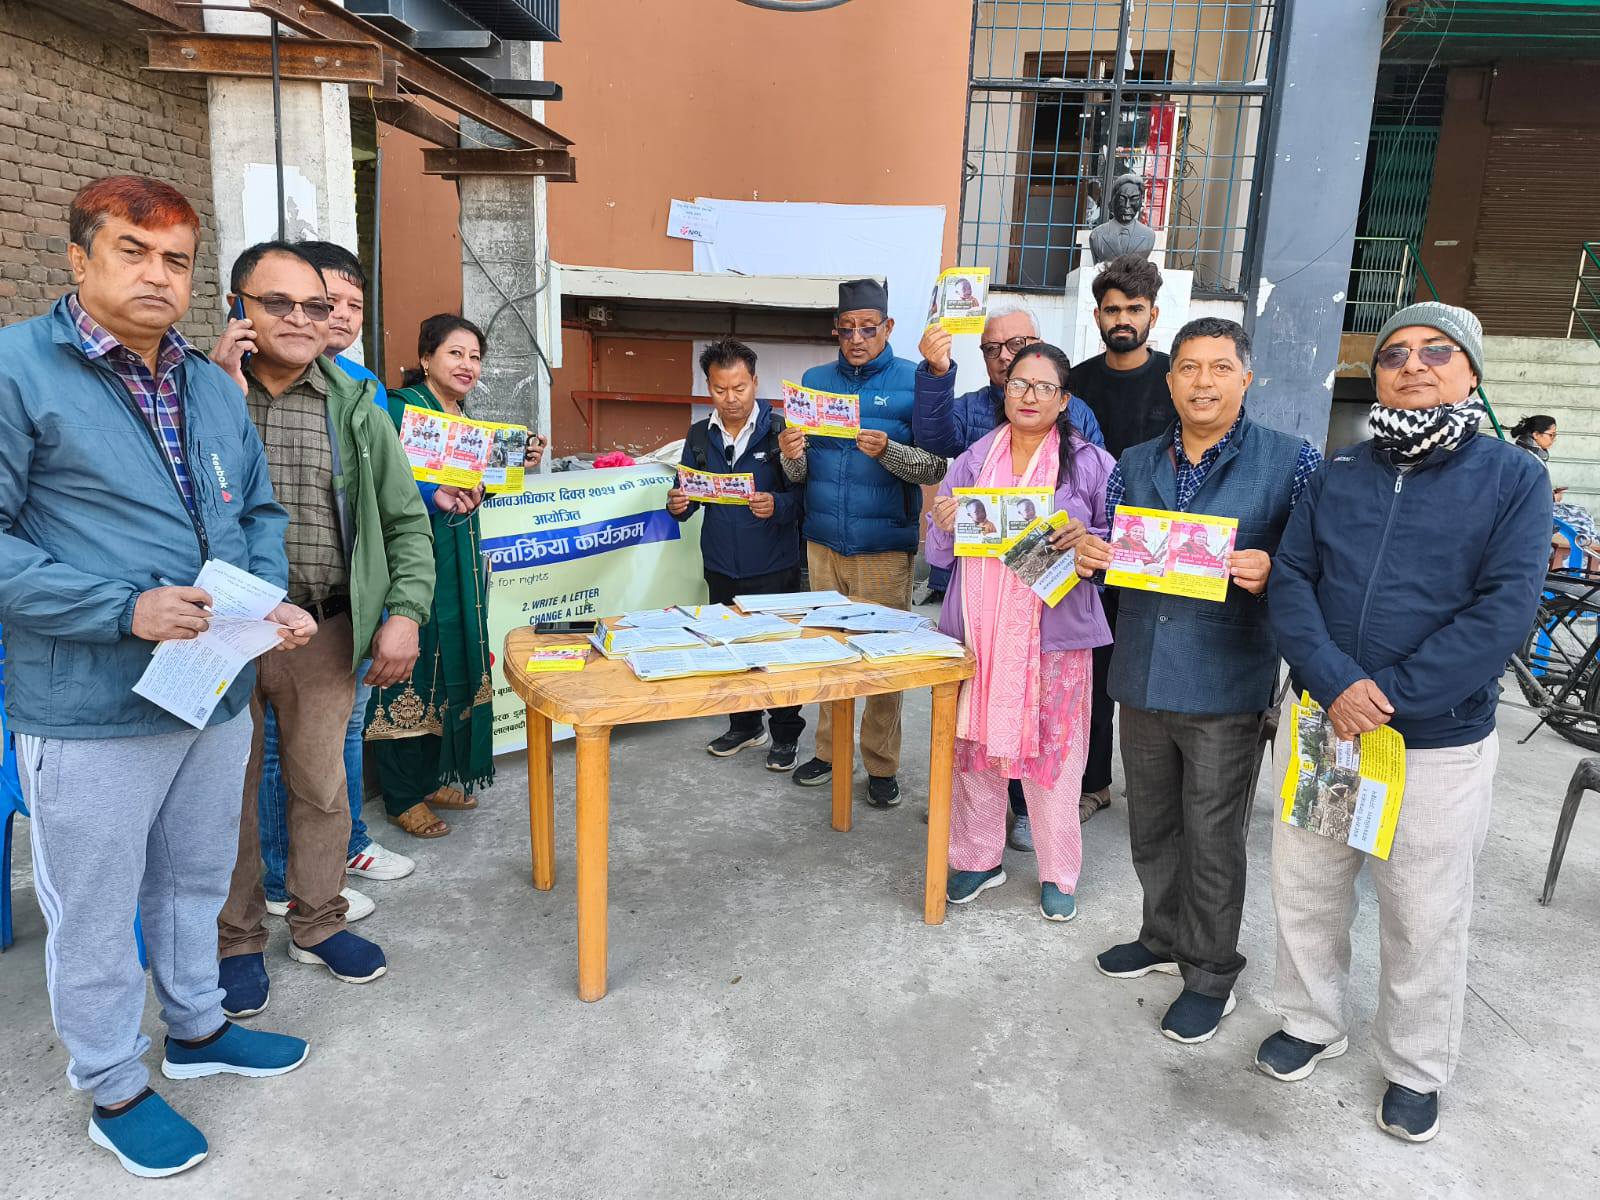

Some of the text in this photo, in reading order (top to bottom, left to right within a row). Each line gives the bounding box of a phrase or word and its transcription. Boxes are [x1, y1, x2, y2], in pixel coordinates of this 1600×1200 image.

[559, 488, 586, 500] दिवस
[588, 486, 616, 498] २०२५
[619, 480, 635, 491] को
[533, 509, 581, 525] आयोजित
[573, 522, 645, 551] कार्यक्रम
[498, 577, 515, 586] for
[519, 572, 550, 586] rights
[522, 588, 599, 611] 2. WRITE A LETTER
[529, 610, 562, 625] CHANGE
[565, 608, 571, 617] A
